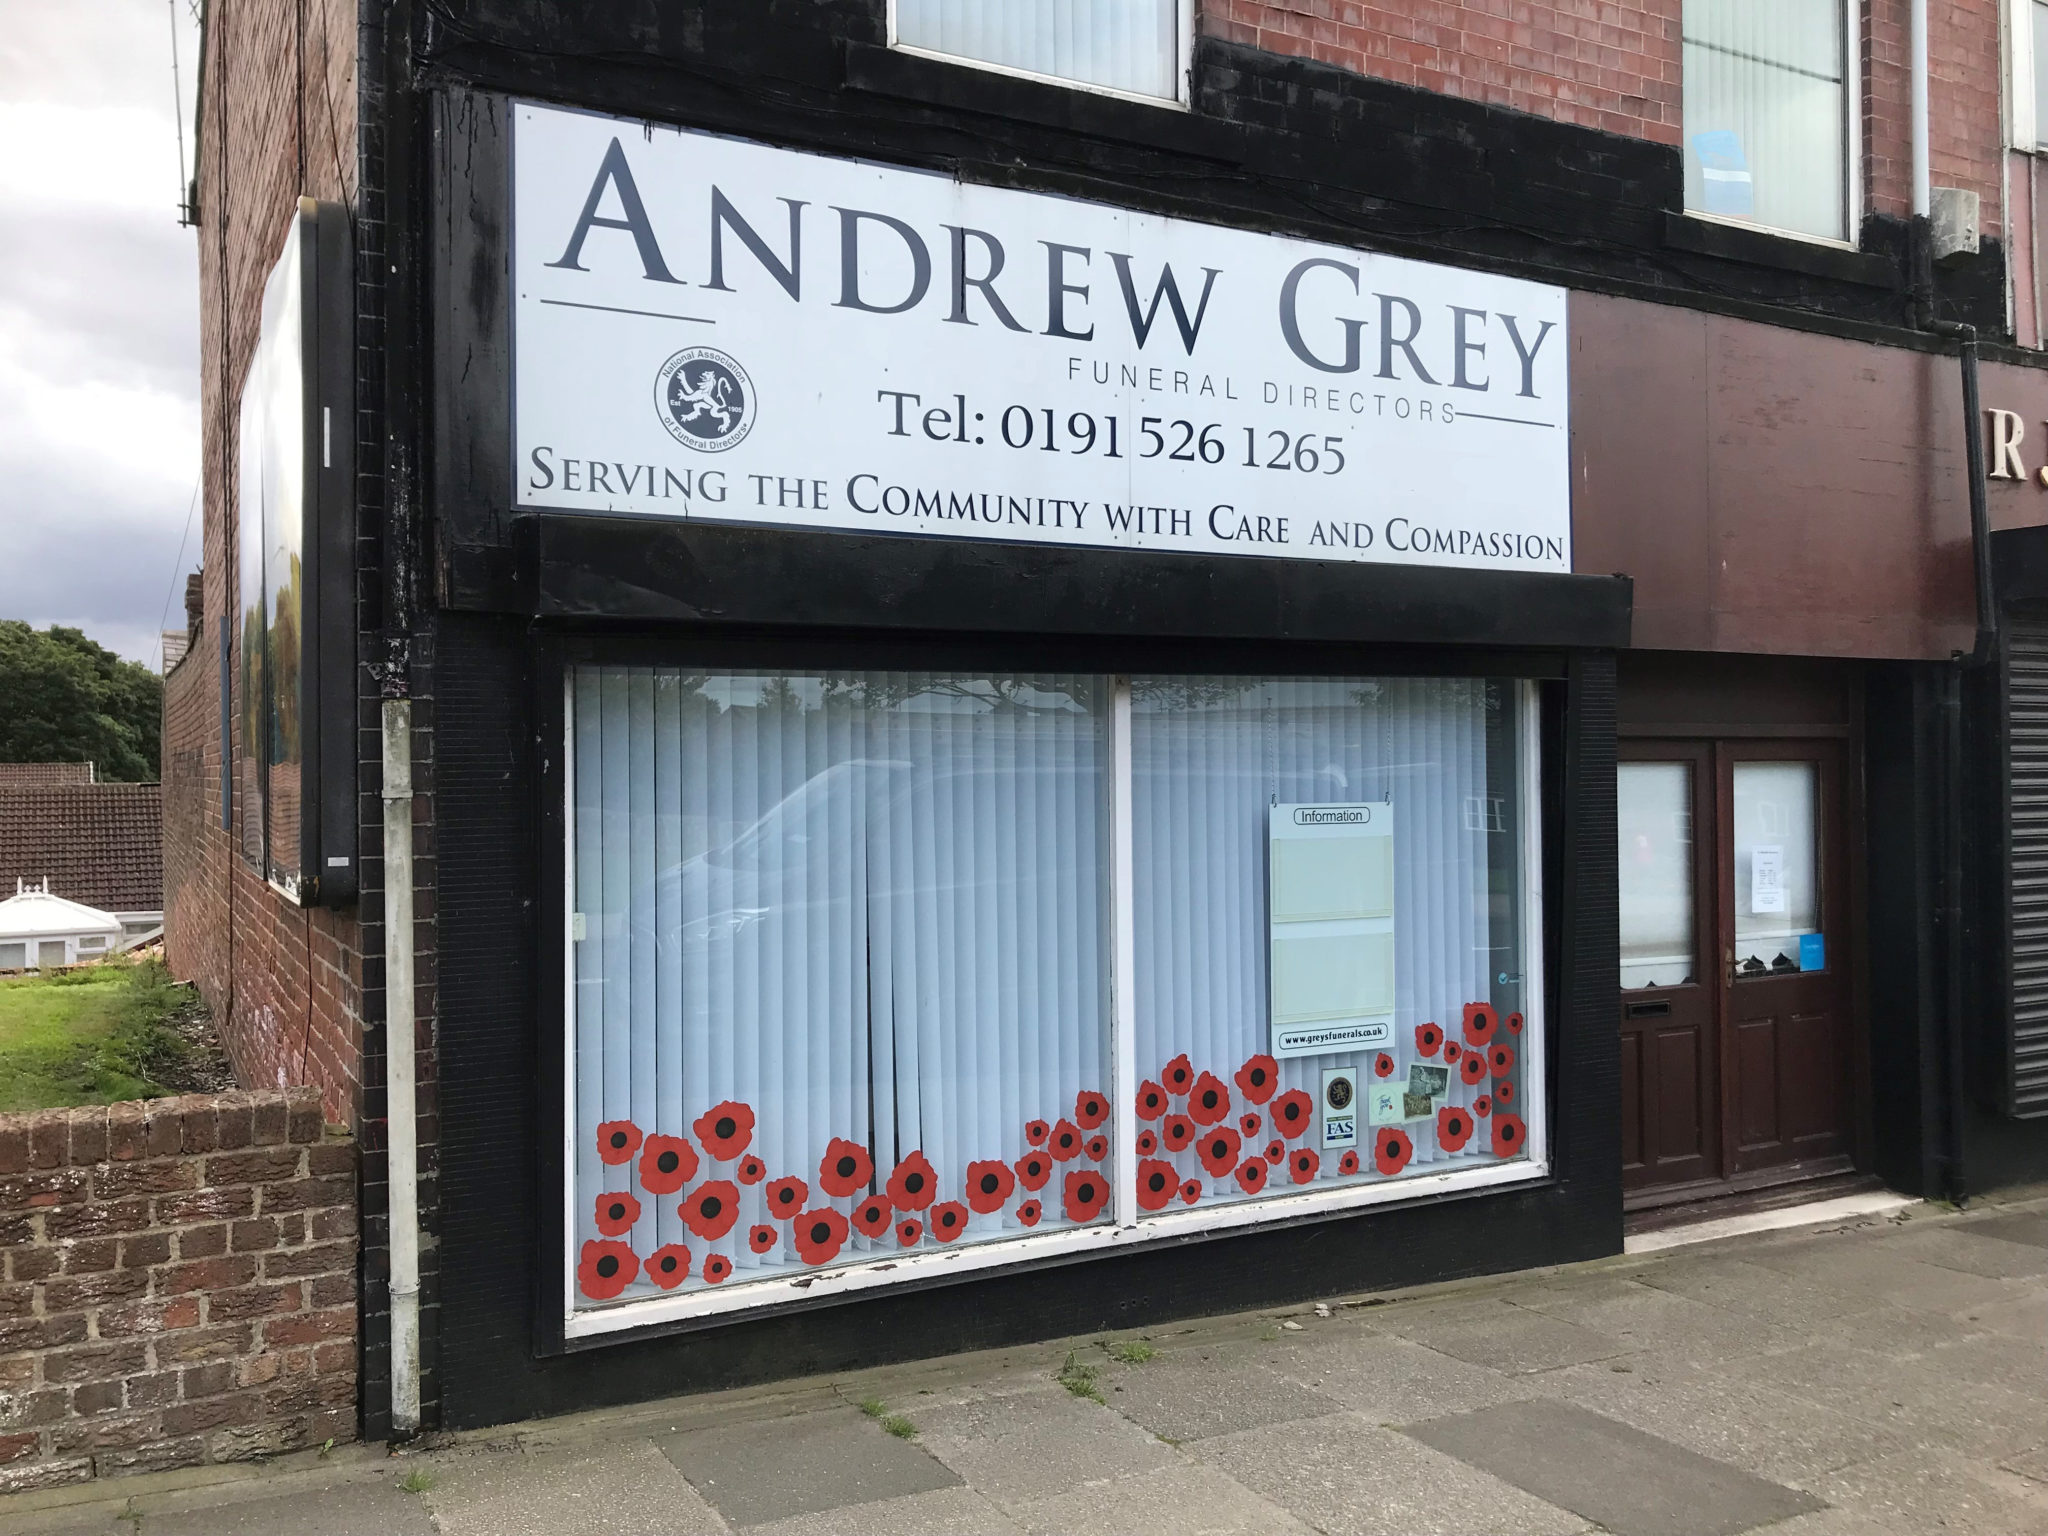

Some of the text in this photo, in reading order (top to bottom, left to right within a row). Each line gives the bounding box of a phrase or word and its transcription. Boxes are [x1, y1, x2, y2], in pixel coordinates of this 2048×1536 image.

[544, 136, 1557, 399] ANDREW GREY
[662, 350, 746, 383] National Association
[1069, 358, 1455, 424] FUNERAL DIRECTORS
[665, 417, 675, 427] of
[673, 426, 707, 449] Funeral
[877, 390, 1345, 475] Tel: 0191 526 1265
[529, 446, 1564, 561] SERVING THE COMMUNITY WITH CARE AND COMPASSION
[1301, 809, 1363, 823] Information
[1285, 1027, 1383, 1045] www.greysfunerals.co.uk
[1326, 1121, 1353, 1135] FAS
